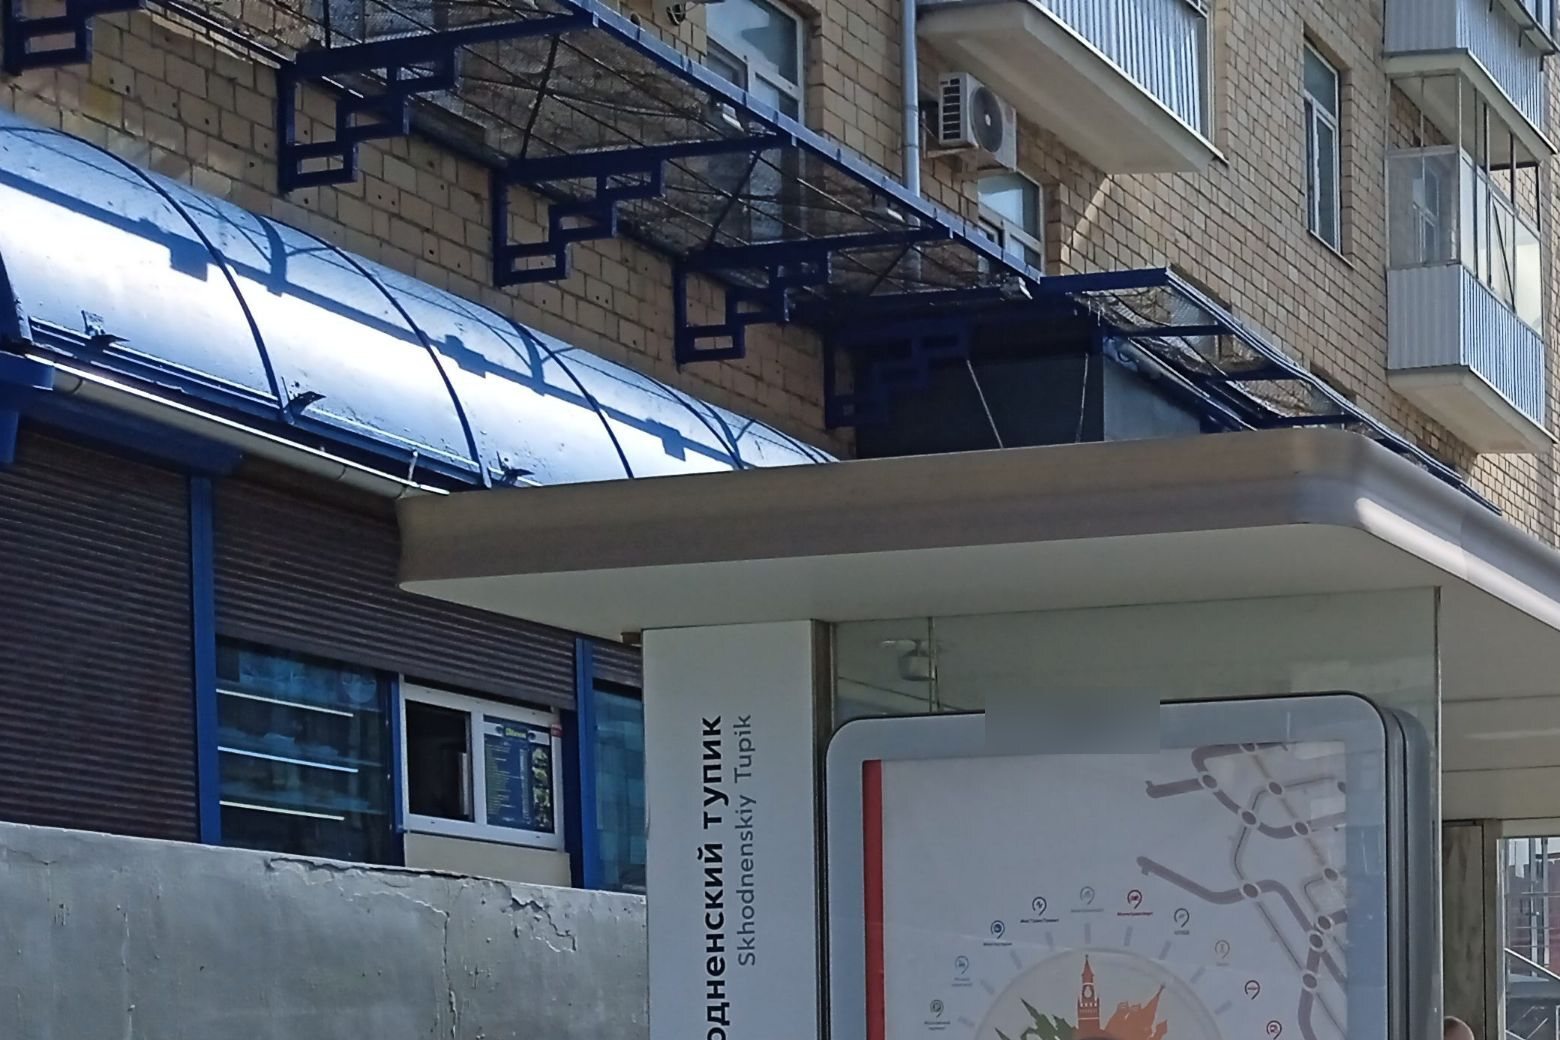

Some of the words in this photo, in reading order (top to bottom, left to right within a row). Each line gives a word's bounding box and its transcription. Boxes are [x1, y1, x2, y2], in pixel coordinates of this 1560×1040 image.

[701, 714, 729, 829] тупик
[733, 713, 757, 784] Tupik
[734, 794, 758, 966] Skhodnenskiy
